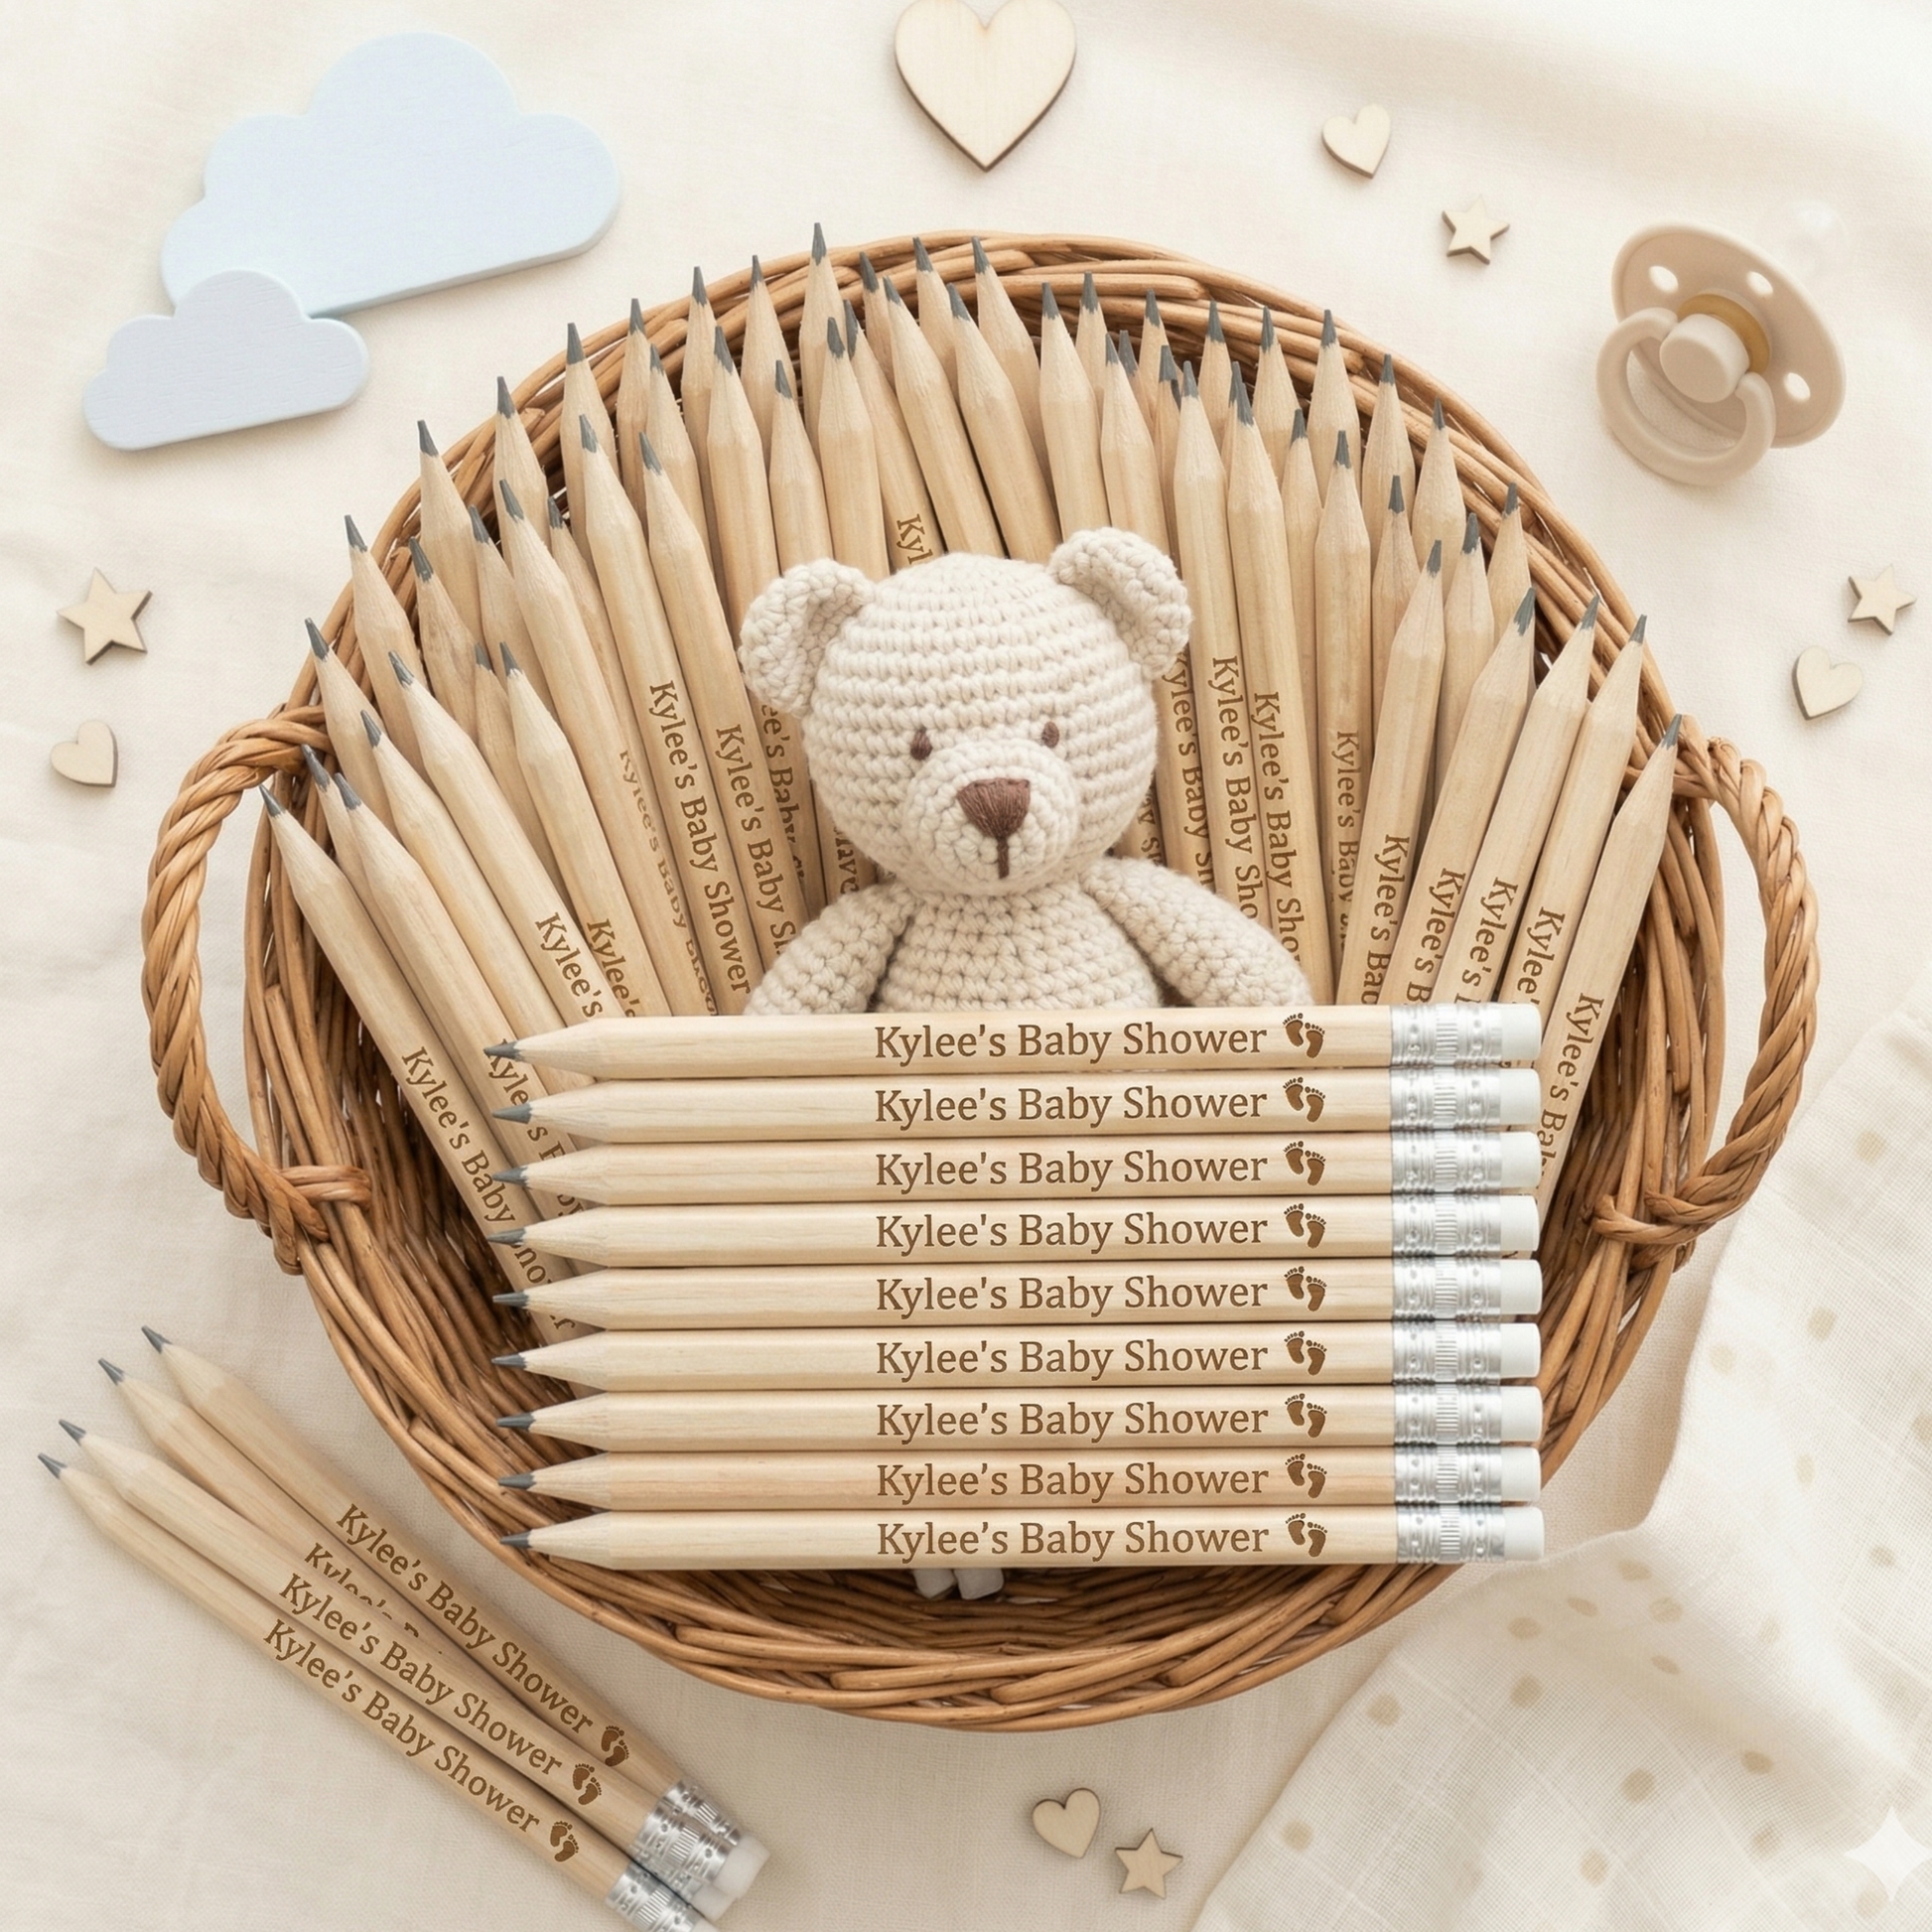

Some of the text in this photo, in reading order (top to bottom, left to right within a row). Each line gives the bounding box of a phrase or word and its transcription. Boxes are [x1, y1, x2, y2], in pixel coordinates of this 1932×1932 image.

[897, 513, 933, 565] Kyl
[715, 724, 764, 832] Kylee's
[747, 838, 785, 913] Baby
[1207, 655, 1264, 919] Kylee's Baby Sho
[1251, 692, 1305, 967] Kylee's Baby Sho
[1331, 730, 1361, 828] Kylee's
[649, 680, 752, 995] Kylee's Baby Shower
[1370, 834, 1410, 941] Kylee's
[535, 912, 604, 1018] Kylee's
[1414, 868, 1466, 974] Kylee's
[1461, 877, 1519, 987] Kylee's
[1517, 906, 1566, 1005] Kylee'
[876, 1022, 1268, 1067] Kylee's Baby Shower
[1550, 993, 1605, 1102] Kylee's
[402, 1046, 471, 1151] Kylee's
[461, 1150, 515, 1224] Baby
[876, 1086, 1268, 1131] Kylee's Baby Shower
[876, 1150, 1268, 1195] Kylee's Baby Shower
[877, 1212, 1268, 1257] Kylee's Baby Shower
[877, 1276, 1268, 1319] Kylee's Baby Shower
[877, 1339, 1268, 1383] Kylee's Baby Shower
[877, 1402, 1268, 1446] Kylee's Baby Shower
[877, 1462, 1268, 1505] Kylee's Baby Shower
[877, 1521, 1268, 1564] Kylee's Baby Shower
[336, 1503, 594, 1734] Kylee's Baby Shower
[263, 1618, 540, 1833] Kylee's Baby Shower
[279, 1573, 563, 1775] Kylee's Baby Shower
